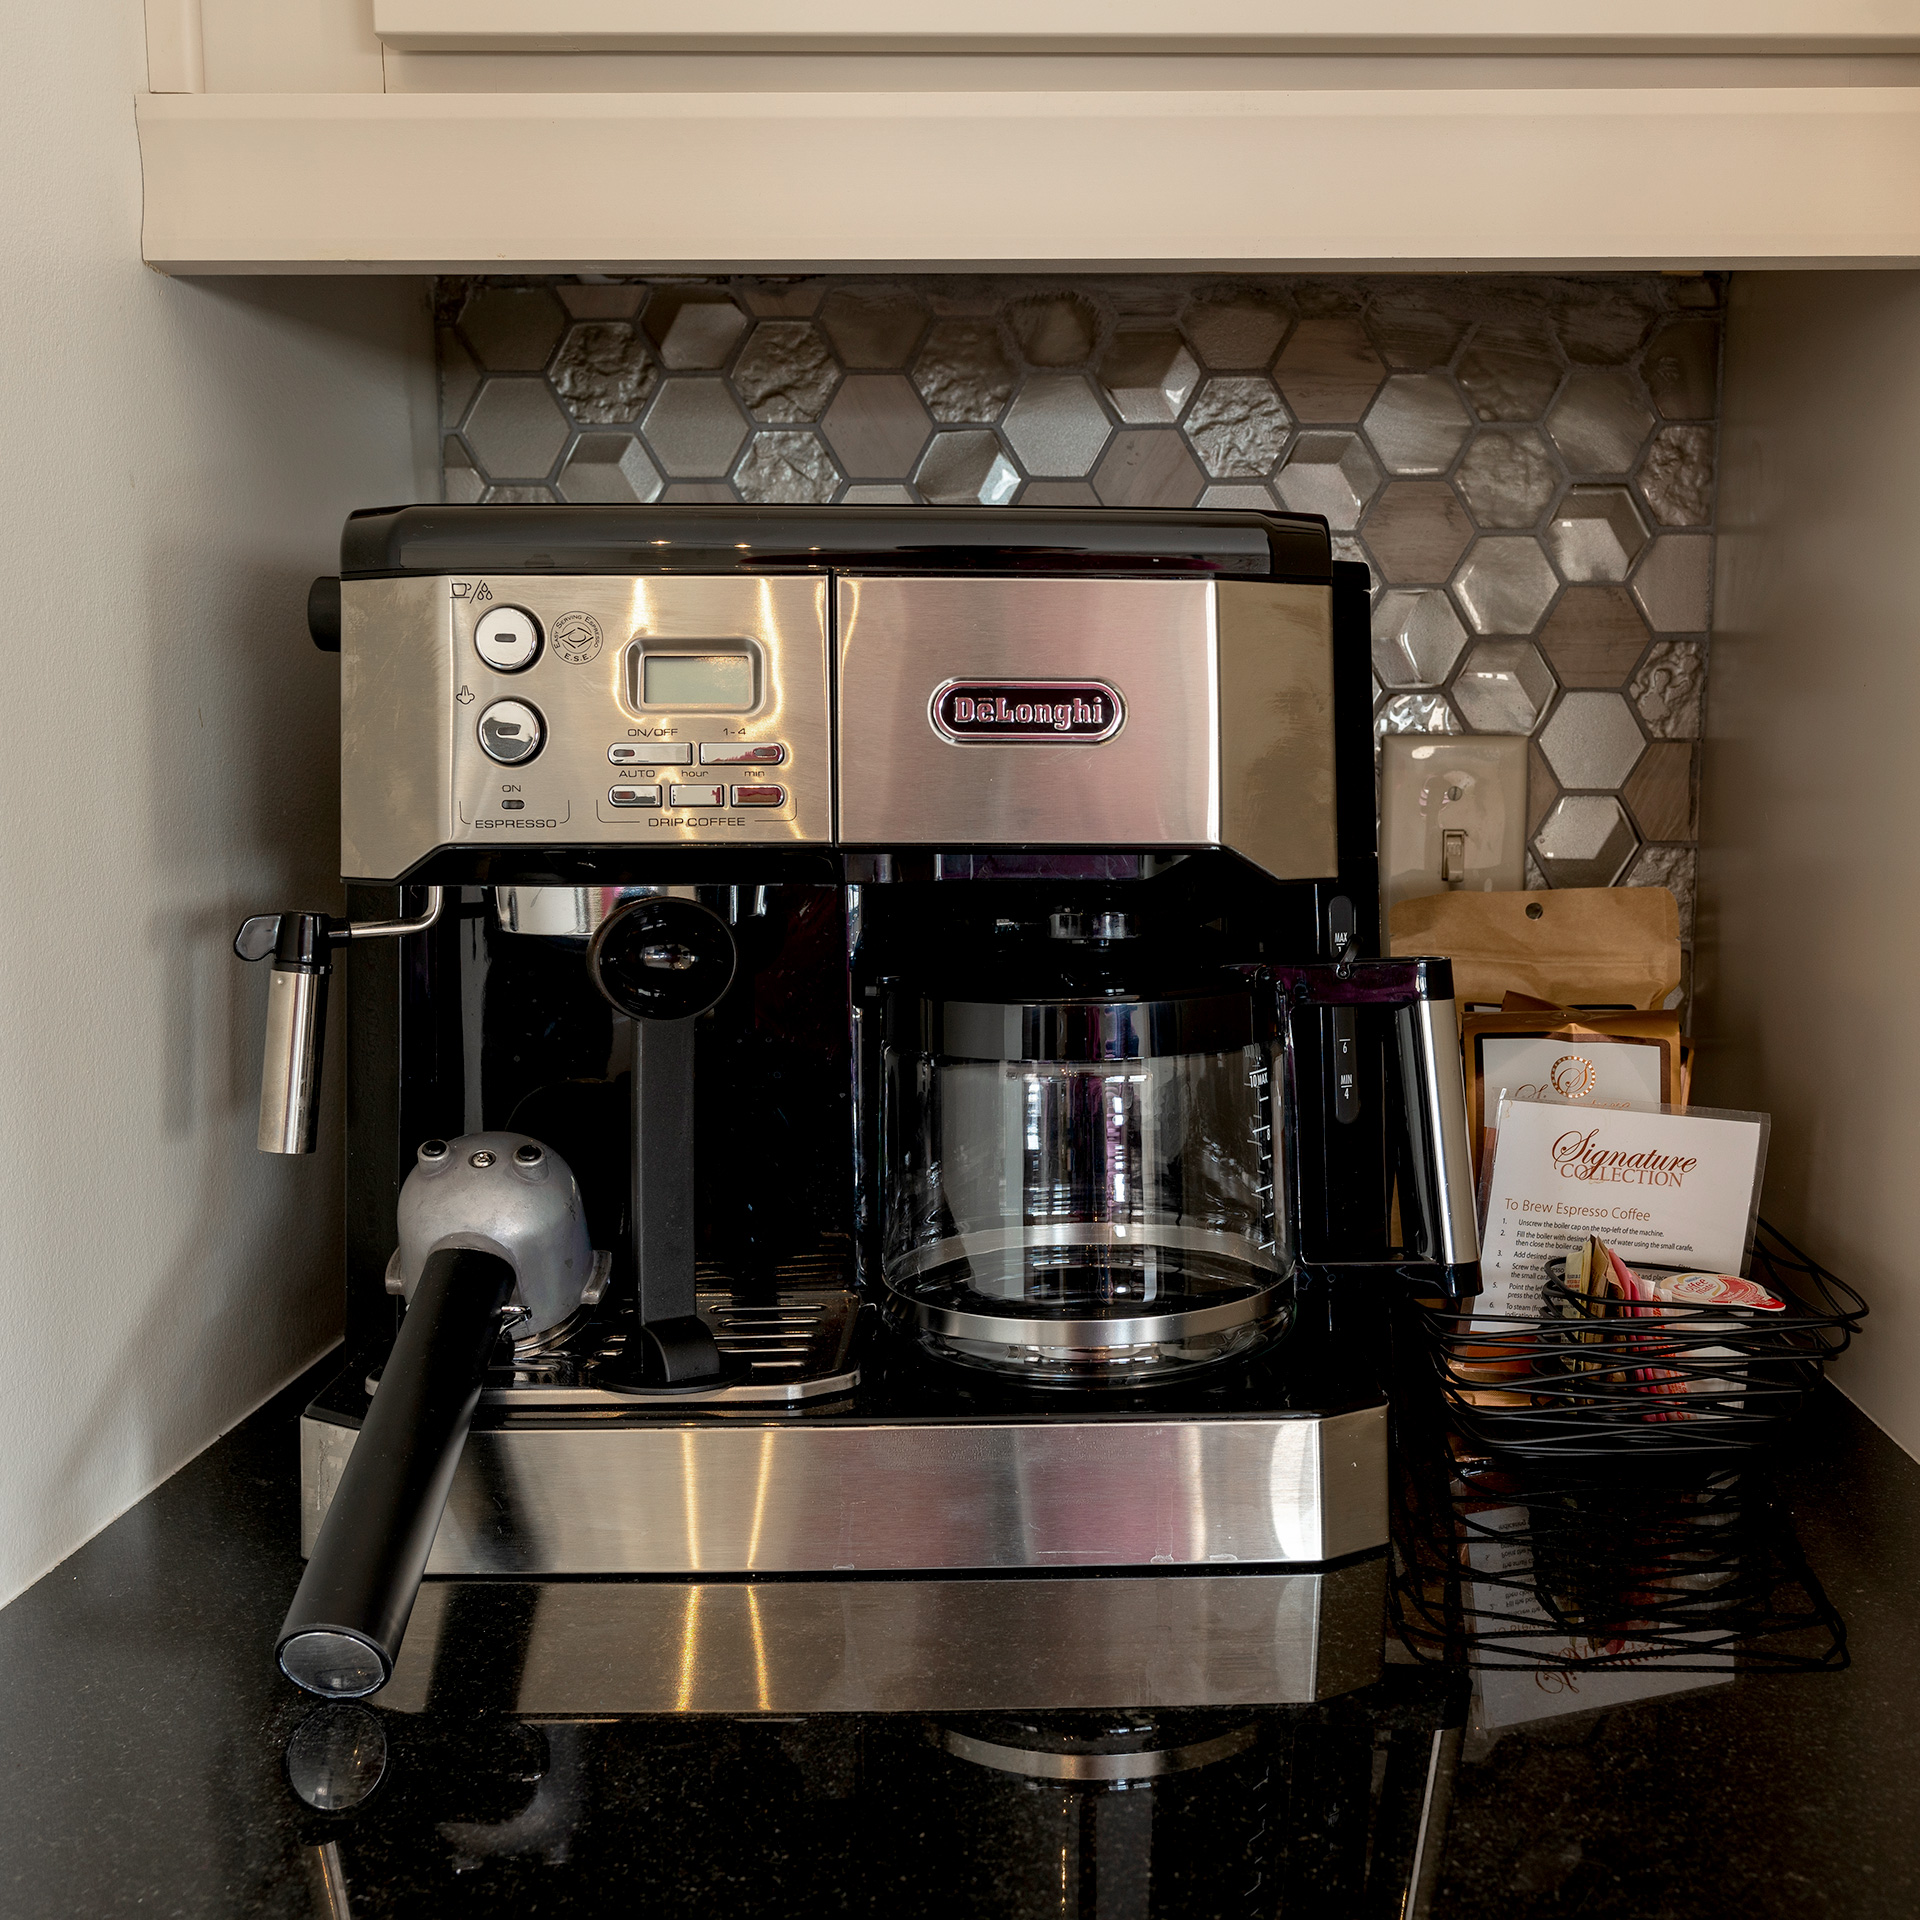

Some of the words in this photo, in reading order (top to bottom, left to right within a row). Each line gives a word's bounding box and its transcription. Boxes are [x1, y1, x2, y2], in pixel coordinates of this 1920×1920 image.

[556, 615, 582, 629] SERVING
[584, 616, 600, 648] ESPRESSO
[564, 652, 592, 662] E.S.E.
[627, 728, 678, 738] ON/OFF
[619, 770, 656, 778] AUTO
[681, 769, 709, 778] hour
[744, 769, 765, 777] min
[501, 784, 522, 793] ON
[475, 819, 557, 829] ESPRESSO
[648, 817, 684, 827] DRIP
[687, 817, 746, 827] COFFEE
[1334, 932, 1348, 943] MAX
[1342, 1042, 1348, 1054] 6
[1249, 1074, 1257, 1088] 10
[1257, 1071, 1269, 1086] MAX
[1340, 1074, 1353, 1085] MIN
[1344, 1088, 1350, 1100] 4
[1551, 1128, 1698, 1180] Signature
[1560, 1163, 1684, 1188] COLLECTION
[1505, 1198, 1519, 1211] To
[1522, 1199, 1553, 1213] Brew
[1556, 1202, 1609, 1218] Espresso
[1611, 1207, 1651, 1222] Coffee
[1518, 1219, 1543, 1228] Unscrew
[1543, 1220, 1553, 1229] the
[1553, 1221, 1571, 1230] boiler
[1570, 1224, 1582, 1232] cap
[1590, 1224, 1600, 1233] the
[1600, 1226, 1621, 1234] top-left
[1622, 1227, 1629, 1235] of
[1629, 1227, 1639, 1236] the
[1639, 1230, 1665, 1238] machine.
[1515, 1239, 1529, 1247] then
[1529, 1240, 1544, 1249] close
[1544, 1241, 1554, 1249] the
[1554, 1242, 1572, 1251] boiler
[1516, 1230, 1525, 1238] Fill
[1525, 1231, 1536, 1239] the
[1536, 1232, 1553, 1240] boiler
[1556, 1233, 1567, 1241] with
[1610, 1238, 1617, 1246] of
[1633, 1241, 1650, 1250] using
[1650, 1241, 1660, 1249] the
[1660, 1242, 1675, 1250] small
[1513, 1250, 1526, 1259] Add
[1526, 1251, 1548, 1260] desired
[1511, 1262, 1529, 1271] Screw
[1529, 1263, 1539, 1272] the
[1510, 1272, 1521, 1280] the
[1521, 1272, 1537, 1281] small
[1508, 1282, 1525, 1290] Point
[1524, 1283, 1535, 1292] the
[1523, 1292, 1534, 1300] the
[1505, 1302, 1514, 1310] To
[1513, 1304, 1531, 1312] steam
